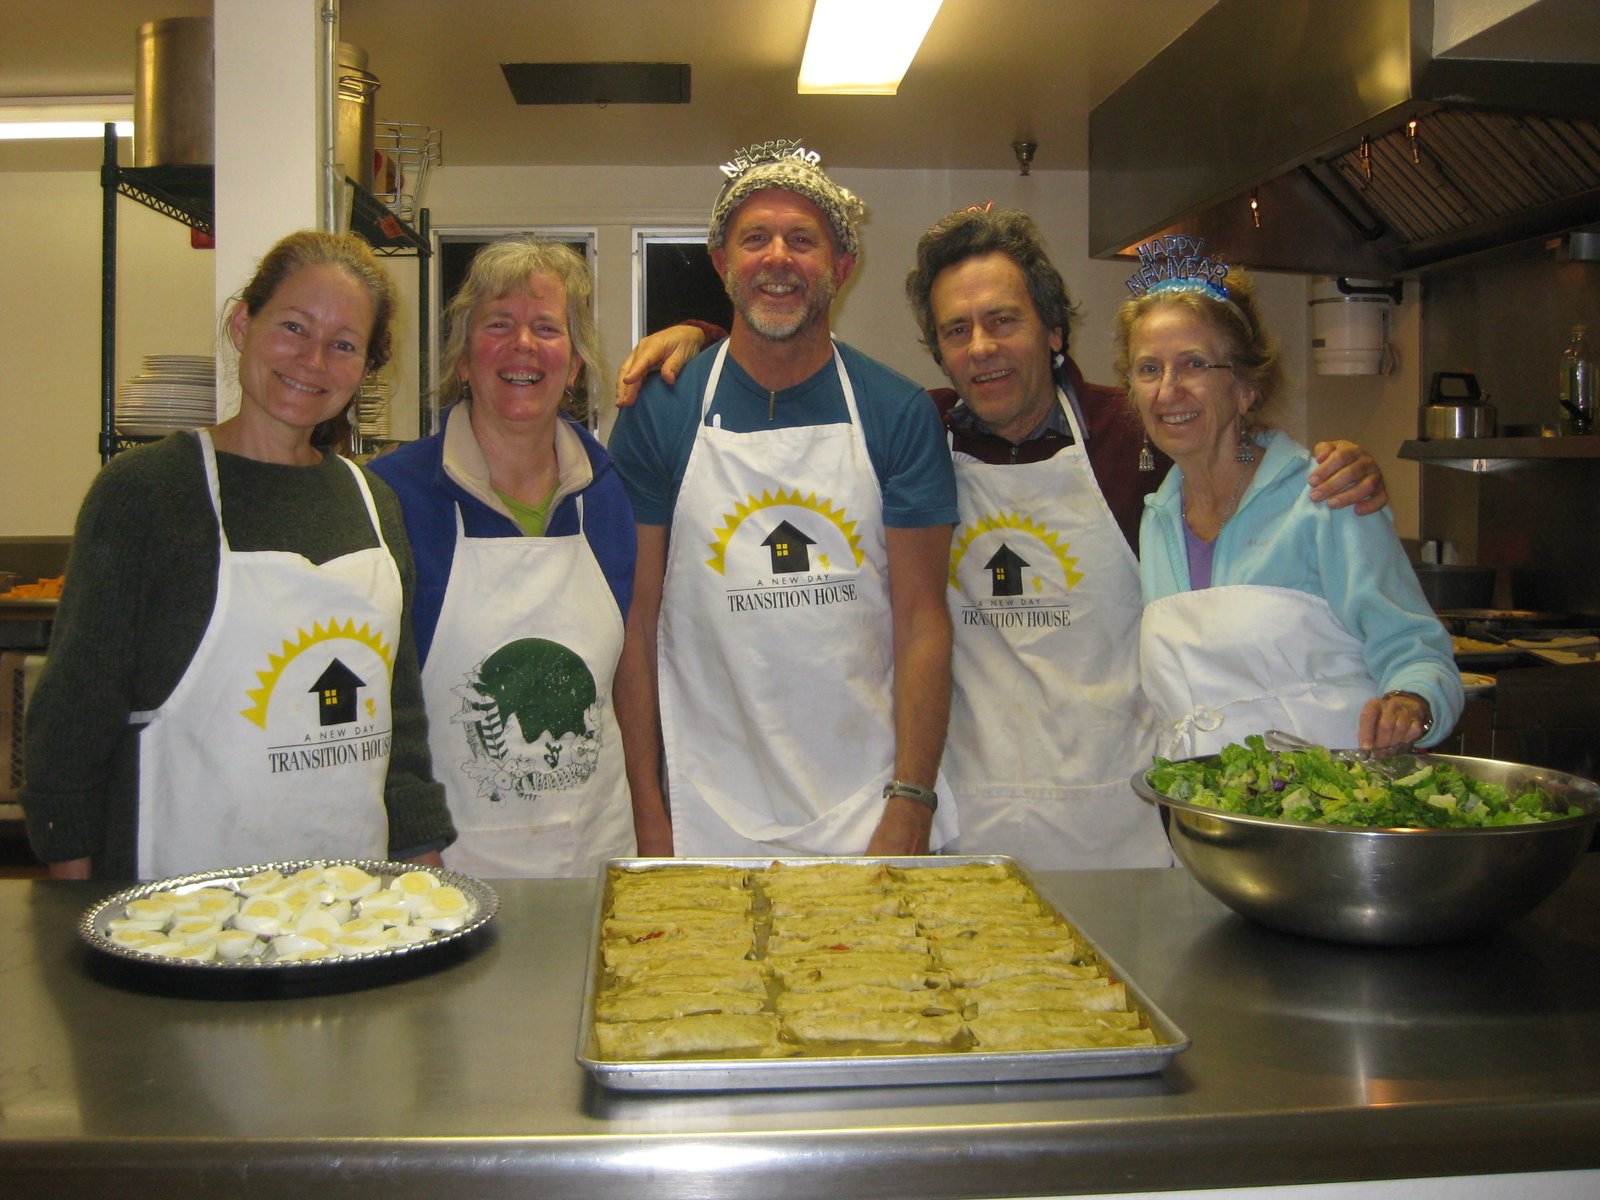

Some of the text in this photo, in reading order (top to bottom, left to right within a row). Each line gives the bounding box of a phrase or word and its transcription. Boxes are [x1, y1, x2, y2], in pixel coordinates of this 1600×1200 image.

[734, 137, 803, 157] HAPPY
[1136, 234, 1204, 266] HAPPY
[1125, 256, 1228, 297] NEW YEAR
[772, 576, 799, 585] NEW
[807, 573, 830, 583] DAY
[727, 583, 858, 612] TRANSITION HOUSE
[1020, 598, 1041, 606] DAY
[1027, 610, 1071, 628] HOUSE
[304, 724, 376, 742] A NEW DAY
[268, 743, 358, 774] TRANSITION
